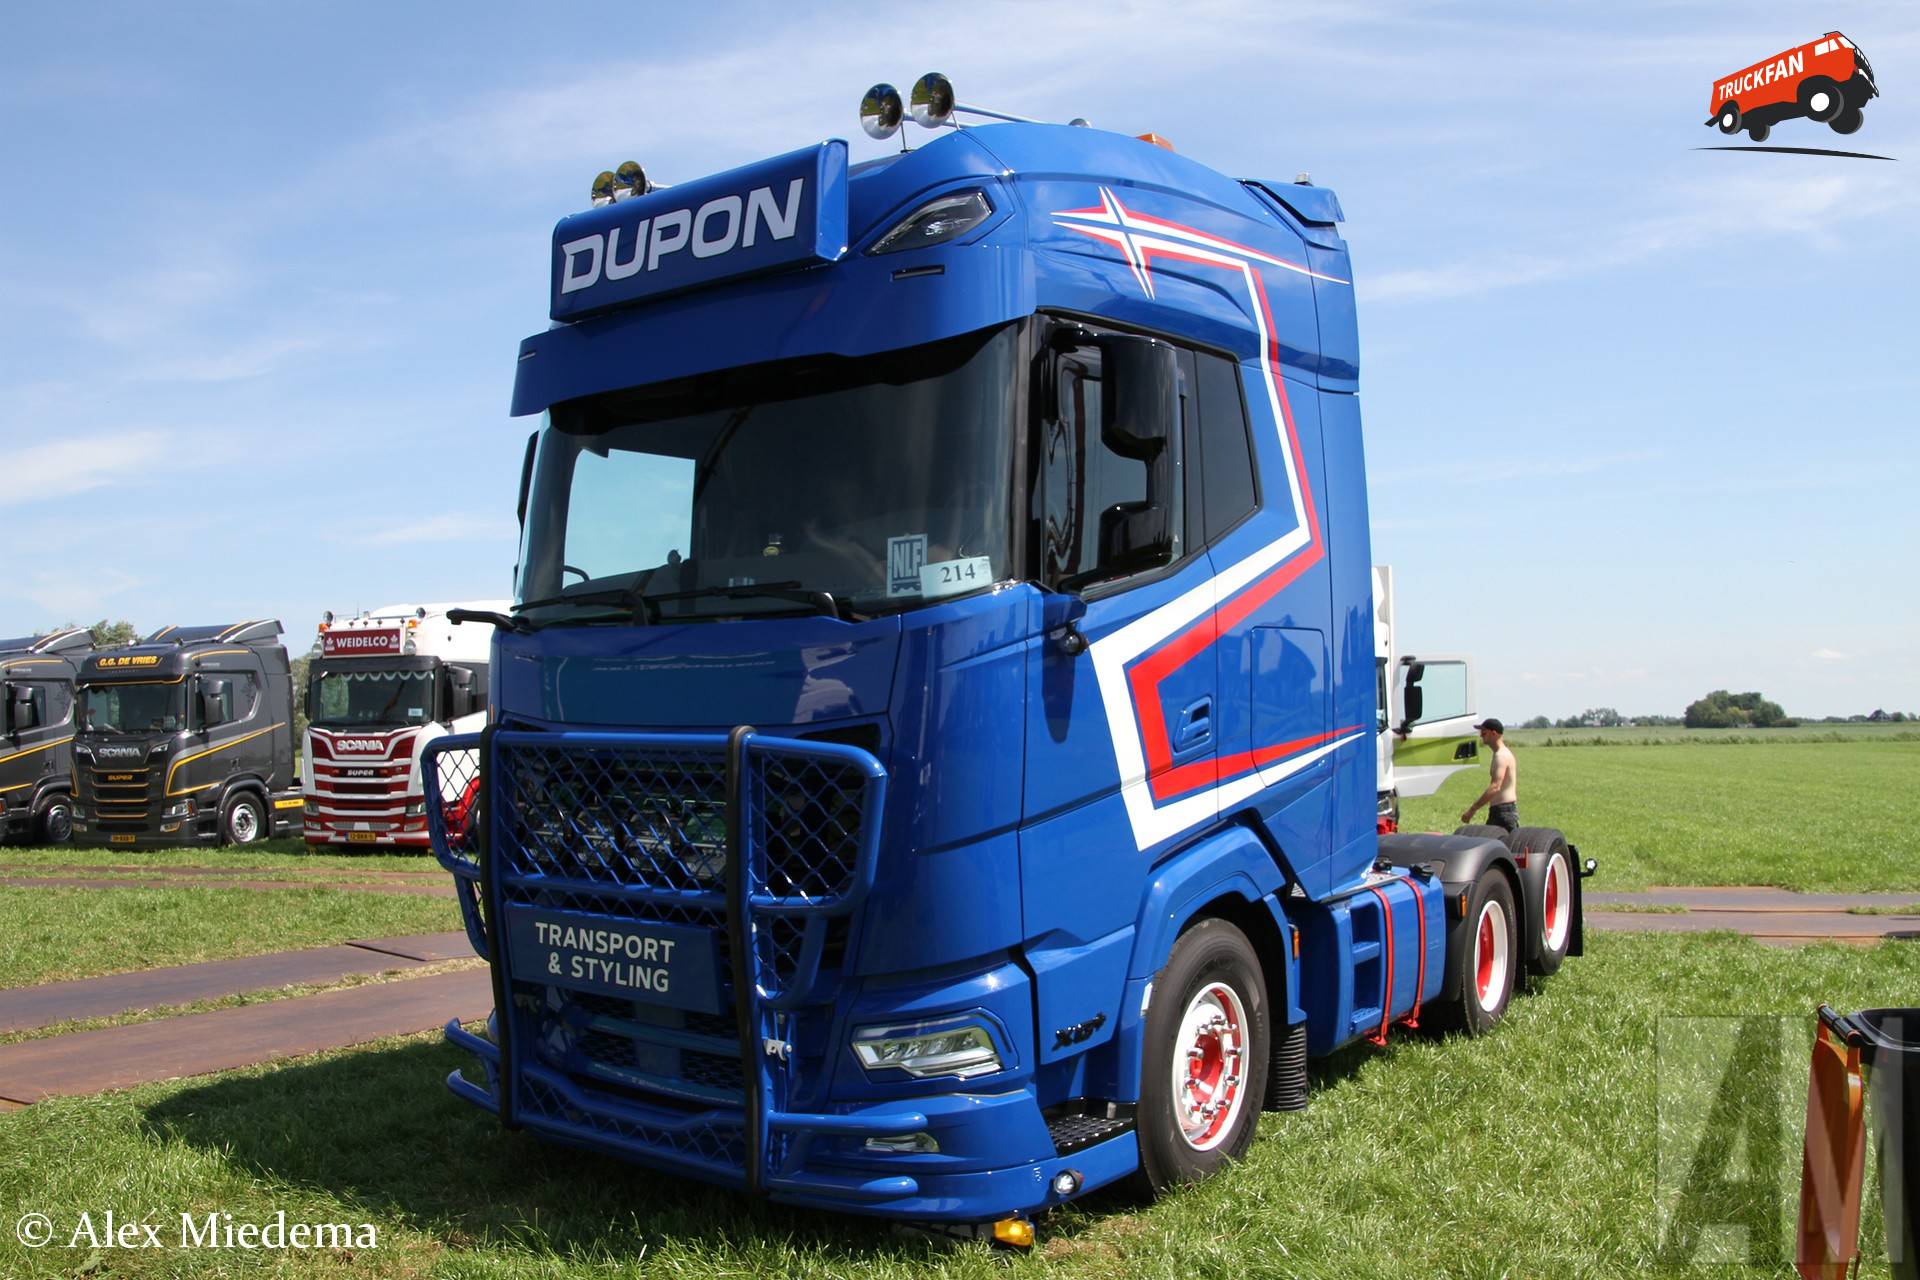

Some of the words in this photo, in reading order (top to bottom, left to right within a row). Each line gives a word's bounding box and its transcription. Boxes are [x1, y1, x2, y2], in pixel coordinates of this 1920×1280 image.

[561, 178, 804, 294] DUPON
[940, 563, 976, 583] 214
[336, 636, 388, 648] WEIDELCO
[118, 656, 130, 665] DE
[132, 656, 158, 665] VRIES
[99, 747, 141, 758] SCANIA
[337, 740, 384, 751] SCANIA
[535, 922, 675, 963] TRANSPORT
[548, 952, 562, 975] &
[571, 956, 669, 992] STYLING
